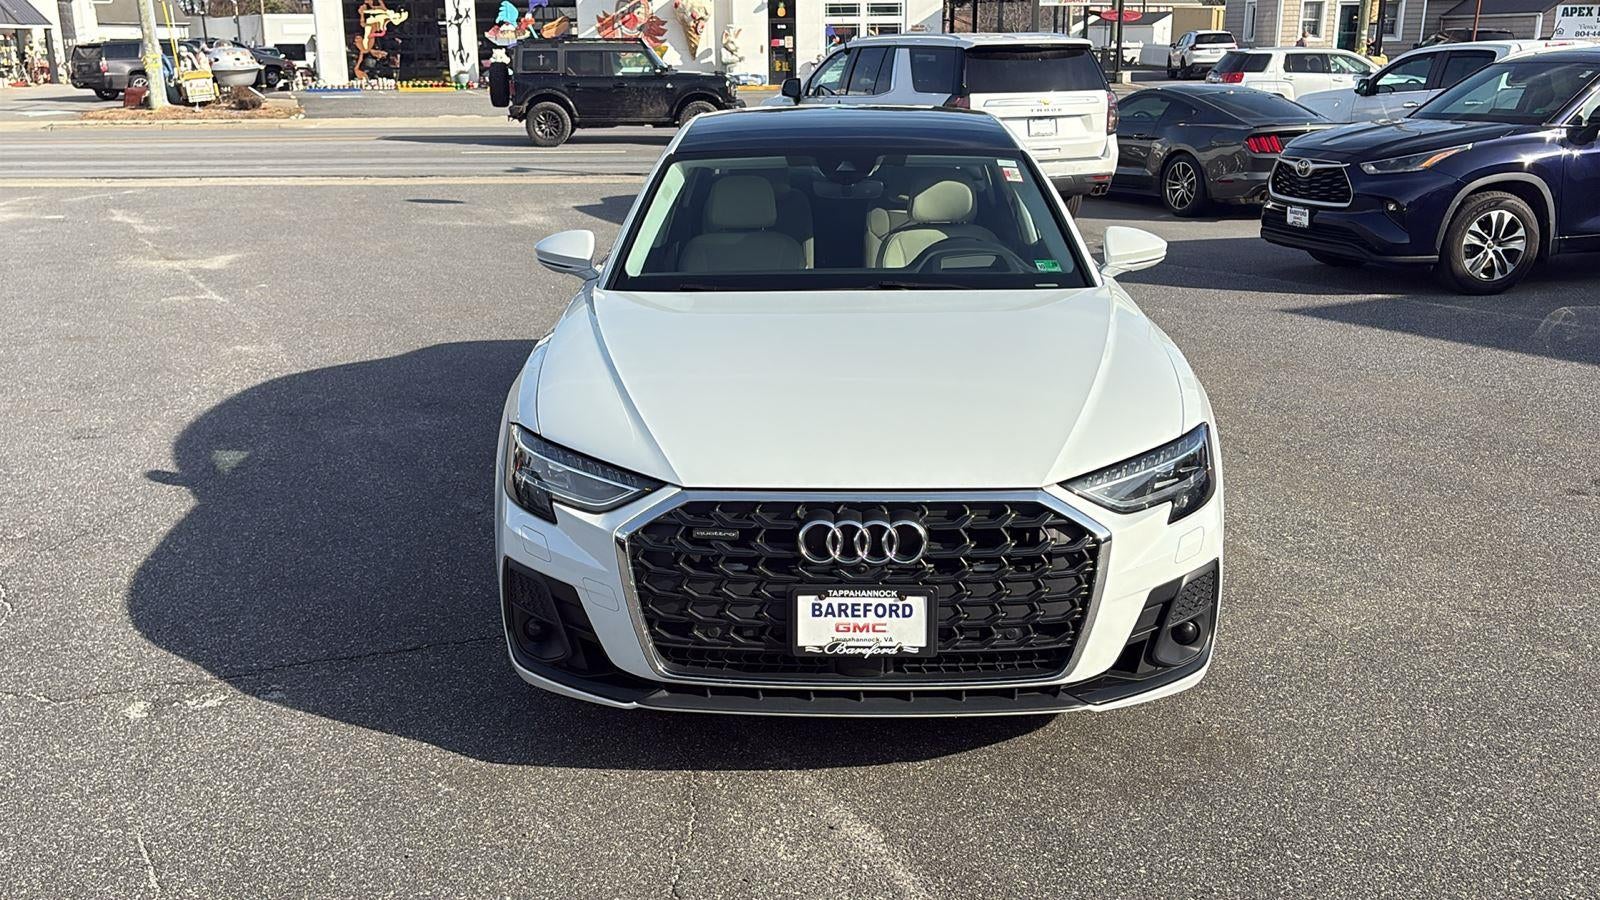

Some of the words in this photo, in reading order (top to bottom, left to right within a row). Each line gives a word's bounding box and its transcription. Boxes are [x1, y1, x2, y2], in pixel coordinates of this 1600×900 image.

[1561, 6, 1594, 17] APEX
[827, 589, 898, 598] TAPPAHANNOCK
[811, 602, 914, 619] BAREFORD
[834, 622, 888, 633] GMC
[823, 640, 902, 659] Bareford
